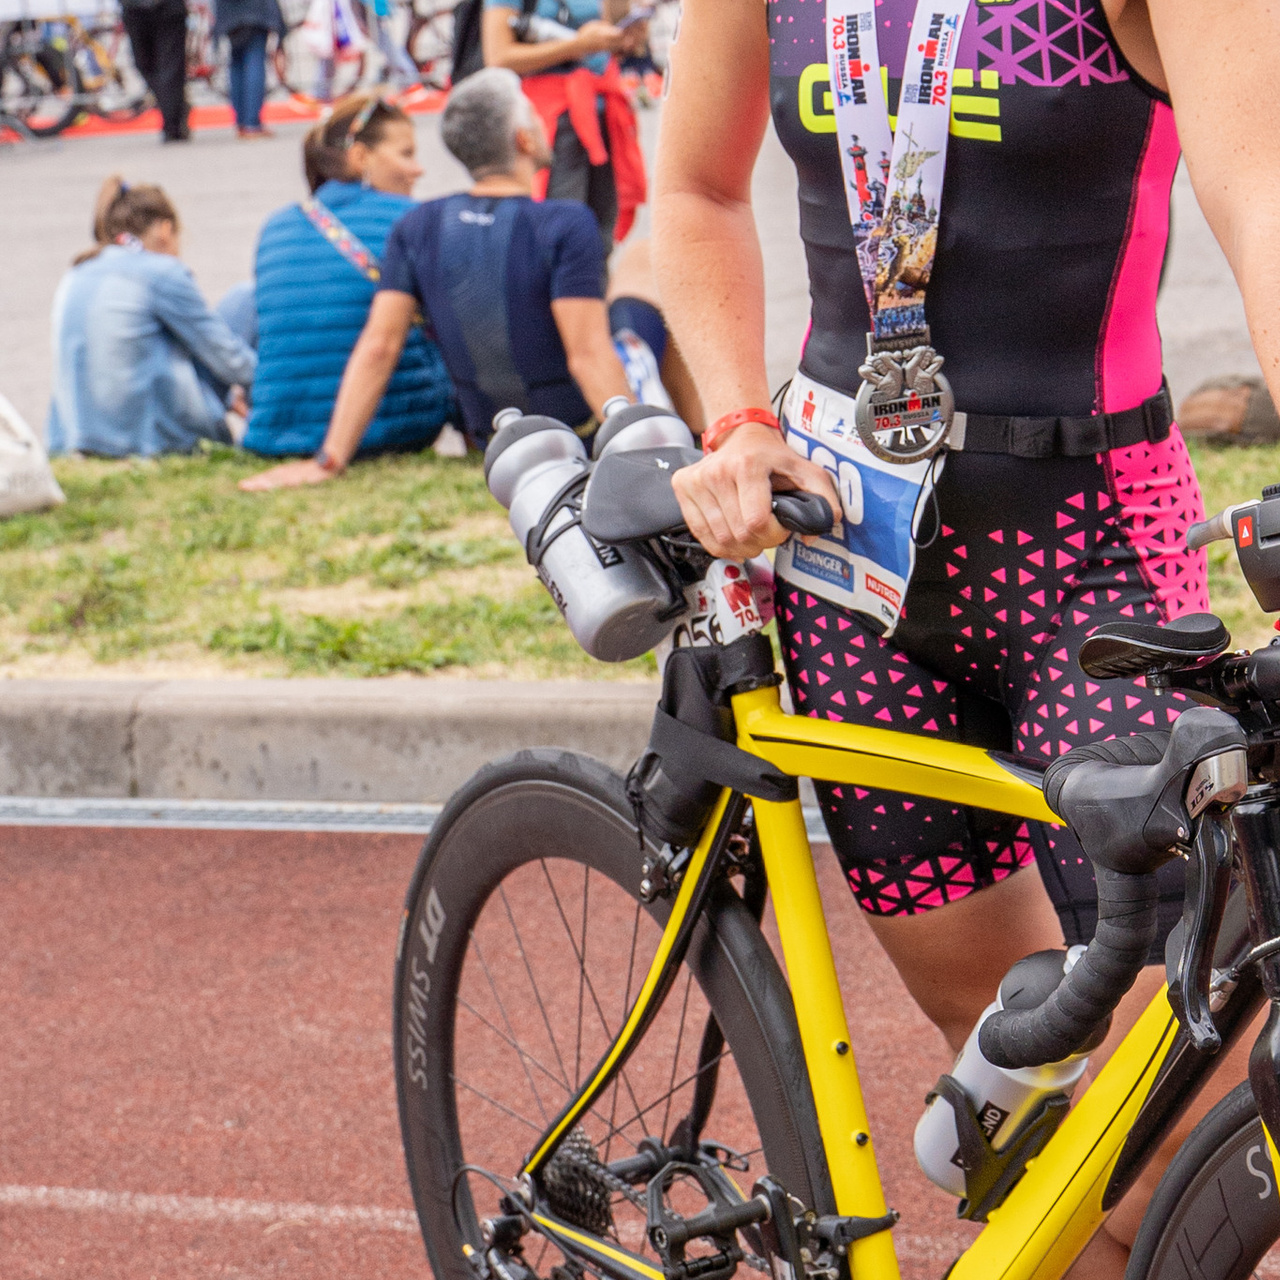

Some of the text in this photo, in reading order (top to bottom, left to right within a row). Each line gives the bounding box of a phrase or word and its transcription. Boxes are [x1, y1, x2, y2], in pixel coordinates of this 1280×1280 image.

[832, 15, 846, 50] 70.3
[937, 30, 950, 67] RUSSIA
[838, 53, 849, 89] RUSSIA
[846, 14, 870, 105] IRONMAN
[917, 13, 945, 105] IRONMAN
[931, 70, 948, 106] 70.3
[873, 392, 942, 417] IRONMAN
[874, 415, 902, 431] 70.3
[796, 545, 843, 577] ERDINGER
[734, 609, 759, 628] 70.
[406, 887, 446, 1090] DT SWISS
